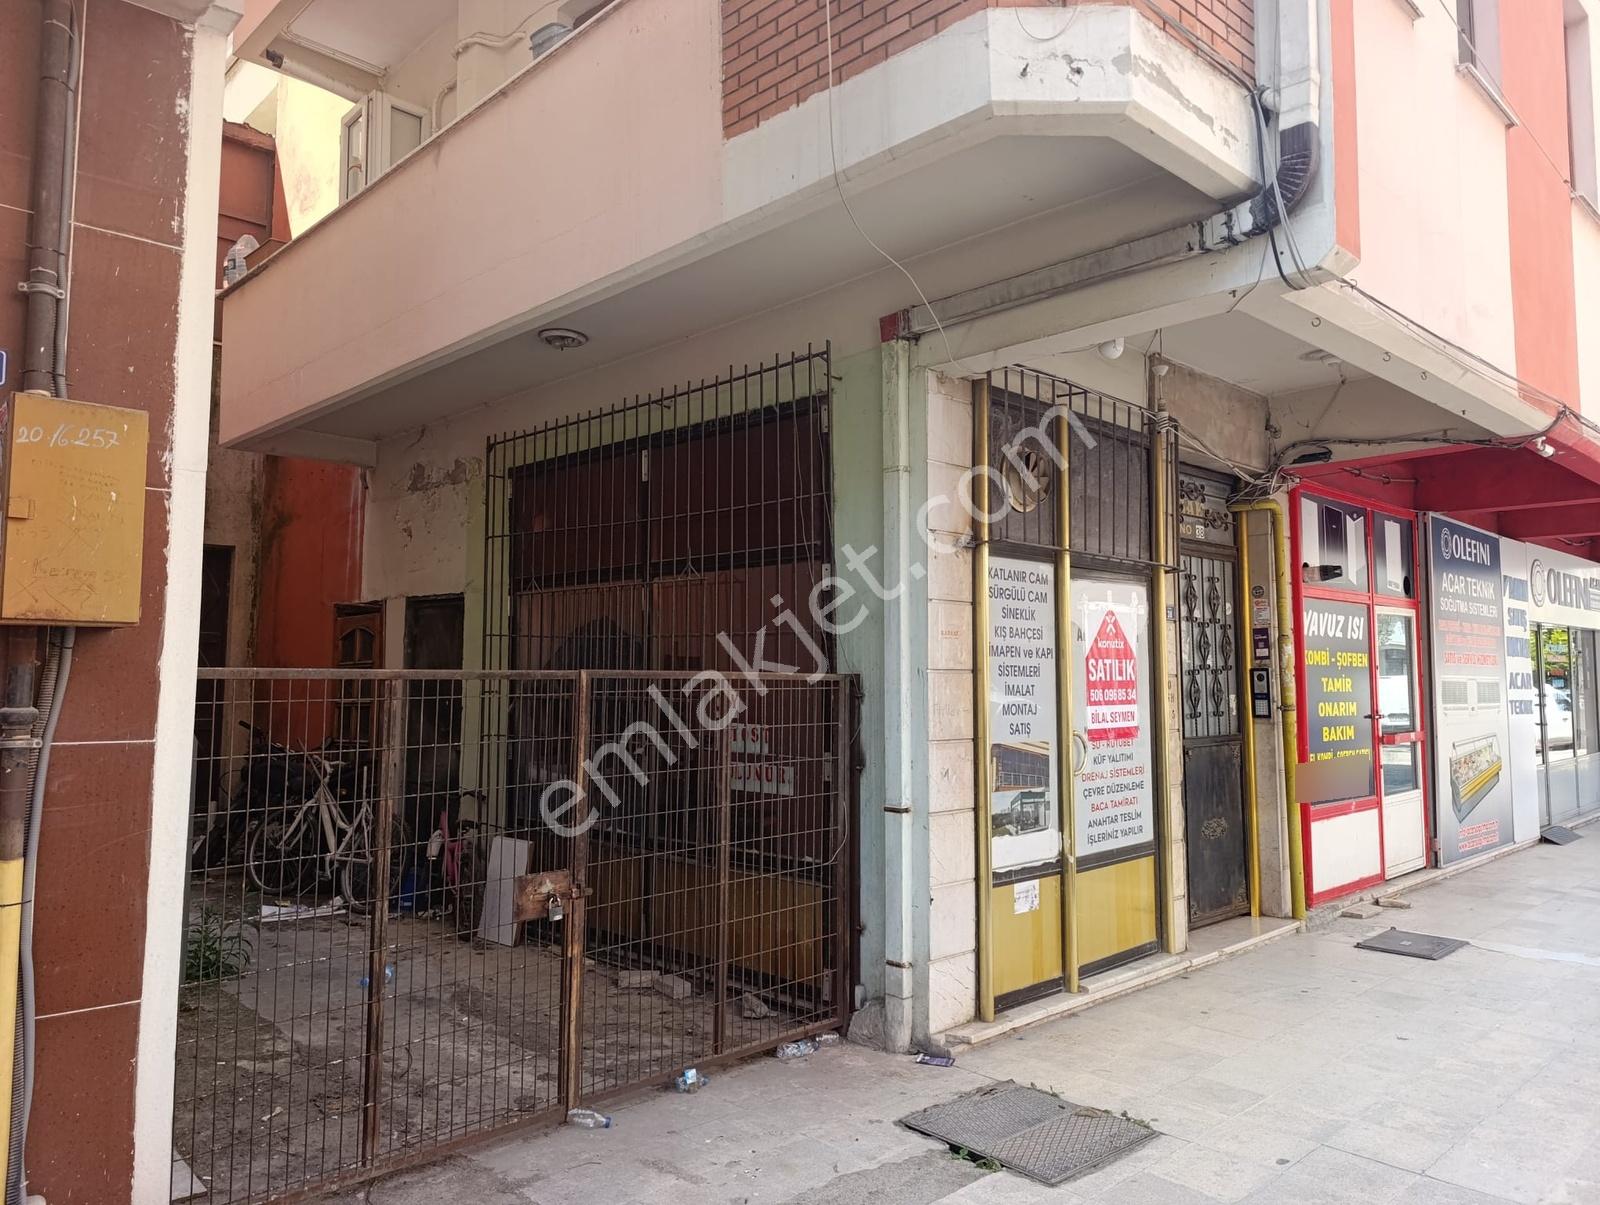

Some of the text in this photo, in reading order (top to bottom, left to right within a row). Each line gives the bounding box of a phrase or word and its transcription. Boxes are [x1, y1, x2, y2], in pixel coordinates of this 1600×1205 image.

[1452, 534, 1491, 566] OLEFINI
[1029, 571, 1049, 585] CAM
[1442, 572, 1465, 595] ACAR
[988, 584, 1048, 604] SÜRGÜLÜ CAM
[1001, 604, 1036, 621] SİNEKLİK
[1304, 609, 1345, 638] YAVUZ
[994, 625, 1044, 643] KIŞ BAHÇESİ
[1023, 648, 1034, 659] ve
[1036, 647, 1054, 659] KAPI
[1337, 652, 1369, 670] ŞOFBEN
[998, 662, 1041, 677] SİSTEMLERİ
[1088, 658, 1136, 681] SATILIK
[1004, 681, 1035, 697] İMALAT
[1321, 674, 1353, 693] TAMİR
[1002, 703, 1038, 717] MONTAJ
[1091, 709, 1109, 725] BİLAL
[1318, 701, 1357, 718] ONARIM
[1009, 722, 1032, 738] SATIŞ
[1322, 725, 1355, 742] BAKIM
[1093, 752, 1134, 766] KÜF YALITIMI
[1081, 765, 1145, 783] DRENAJ SİSTEMLERİ
[1083, 780, 1145, 800] ÇEVRE DÜZENLEME
[1091, 796, 1139, 813] BACA TAMİRATI
[1087, 808, 1142, 829] ANAHTAR TESLİM
[1087, 824, 1144, 847] İŞLERİNİZ YAPILIR
